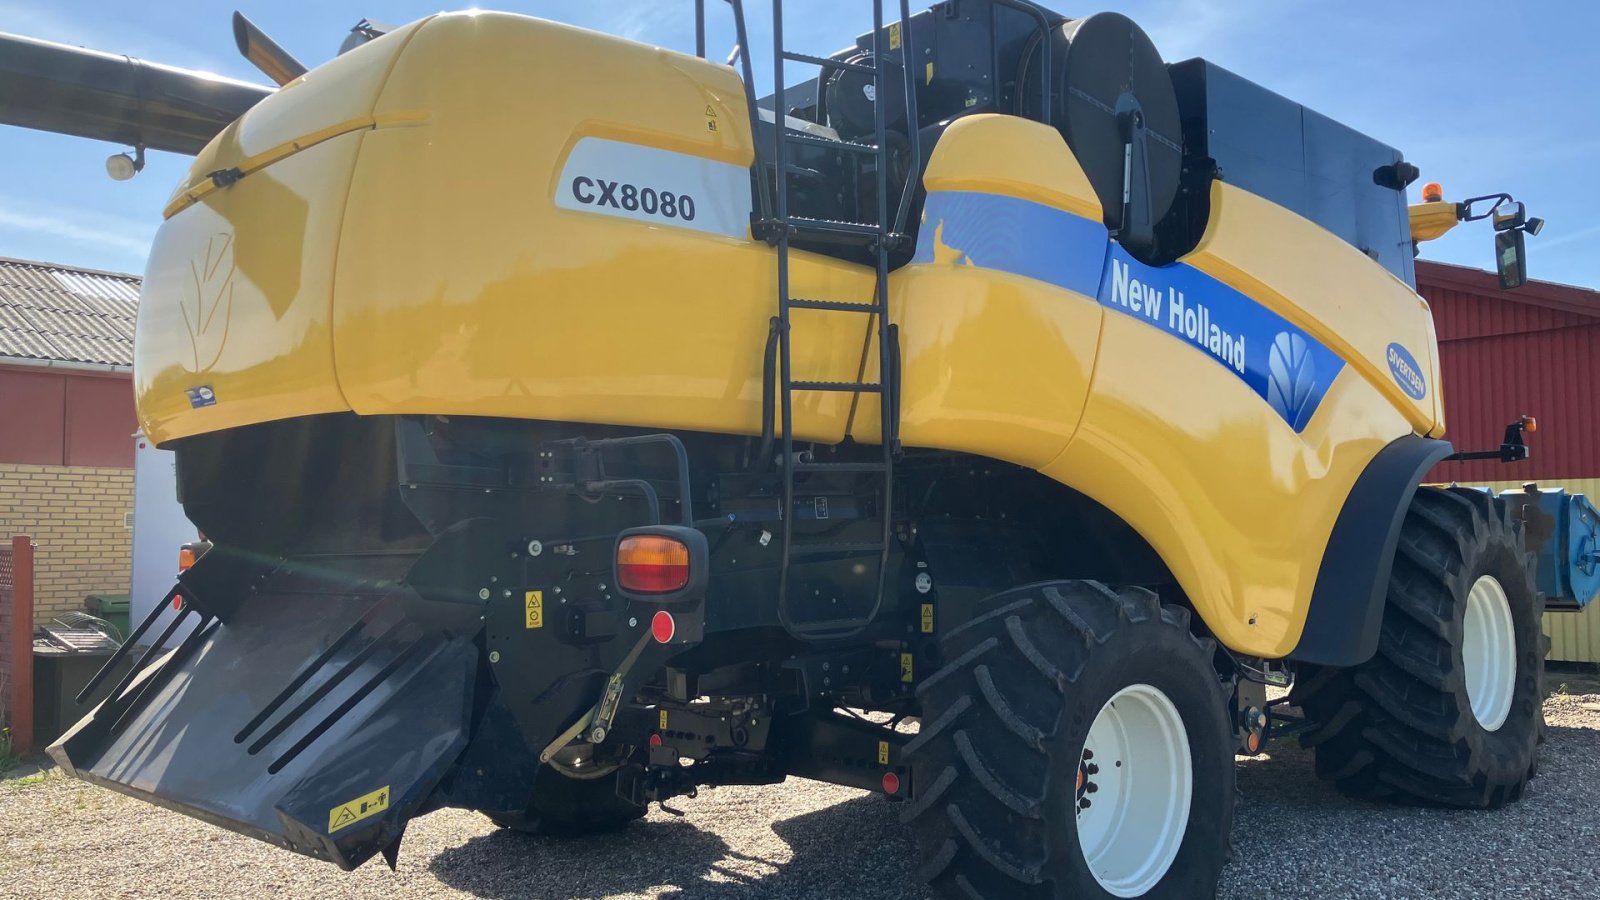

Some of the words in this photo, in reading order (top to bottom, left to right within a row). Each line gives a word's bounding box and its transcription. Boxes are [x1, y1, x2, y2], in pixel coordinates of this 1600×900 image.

[572, 176, 696, 221] CX8080
[1111, 258, 1162, 321] New
[1168, 286, 1246, 374] Holland
[1388, 347, 1424, 395] SIVERTSEN
